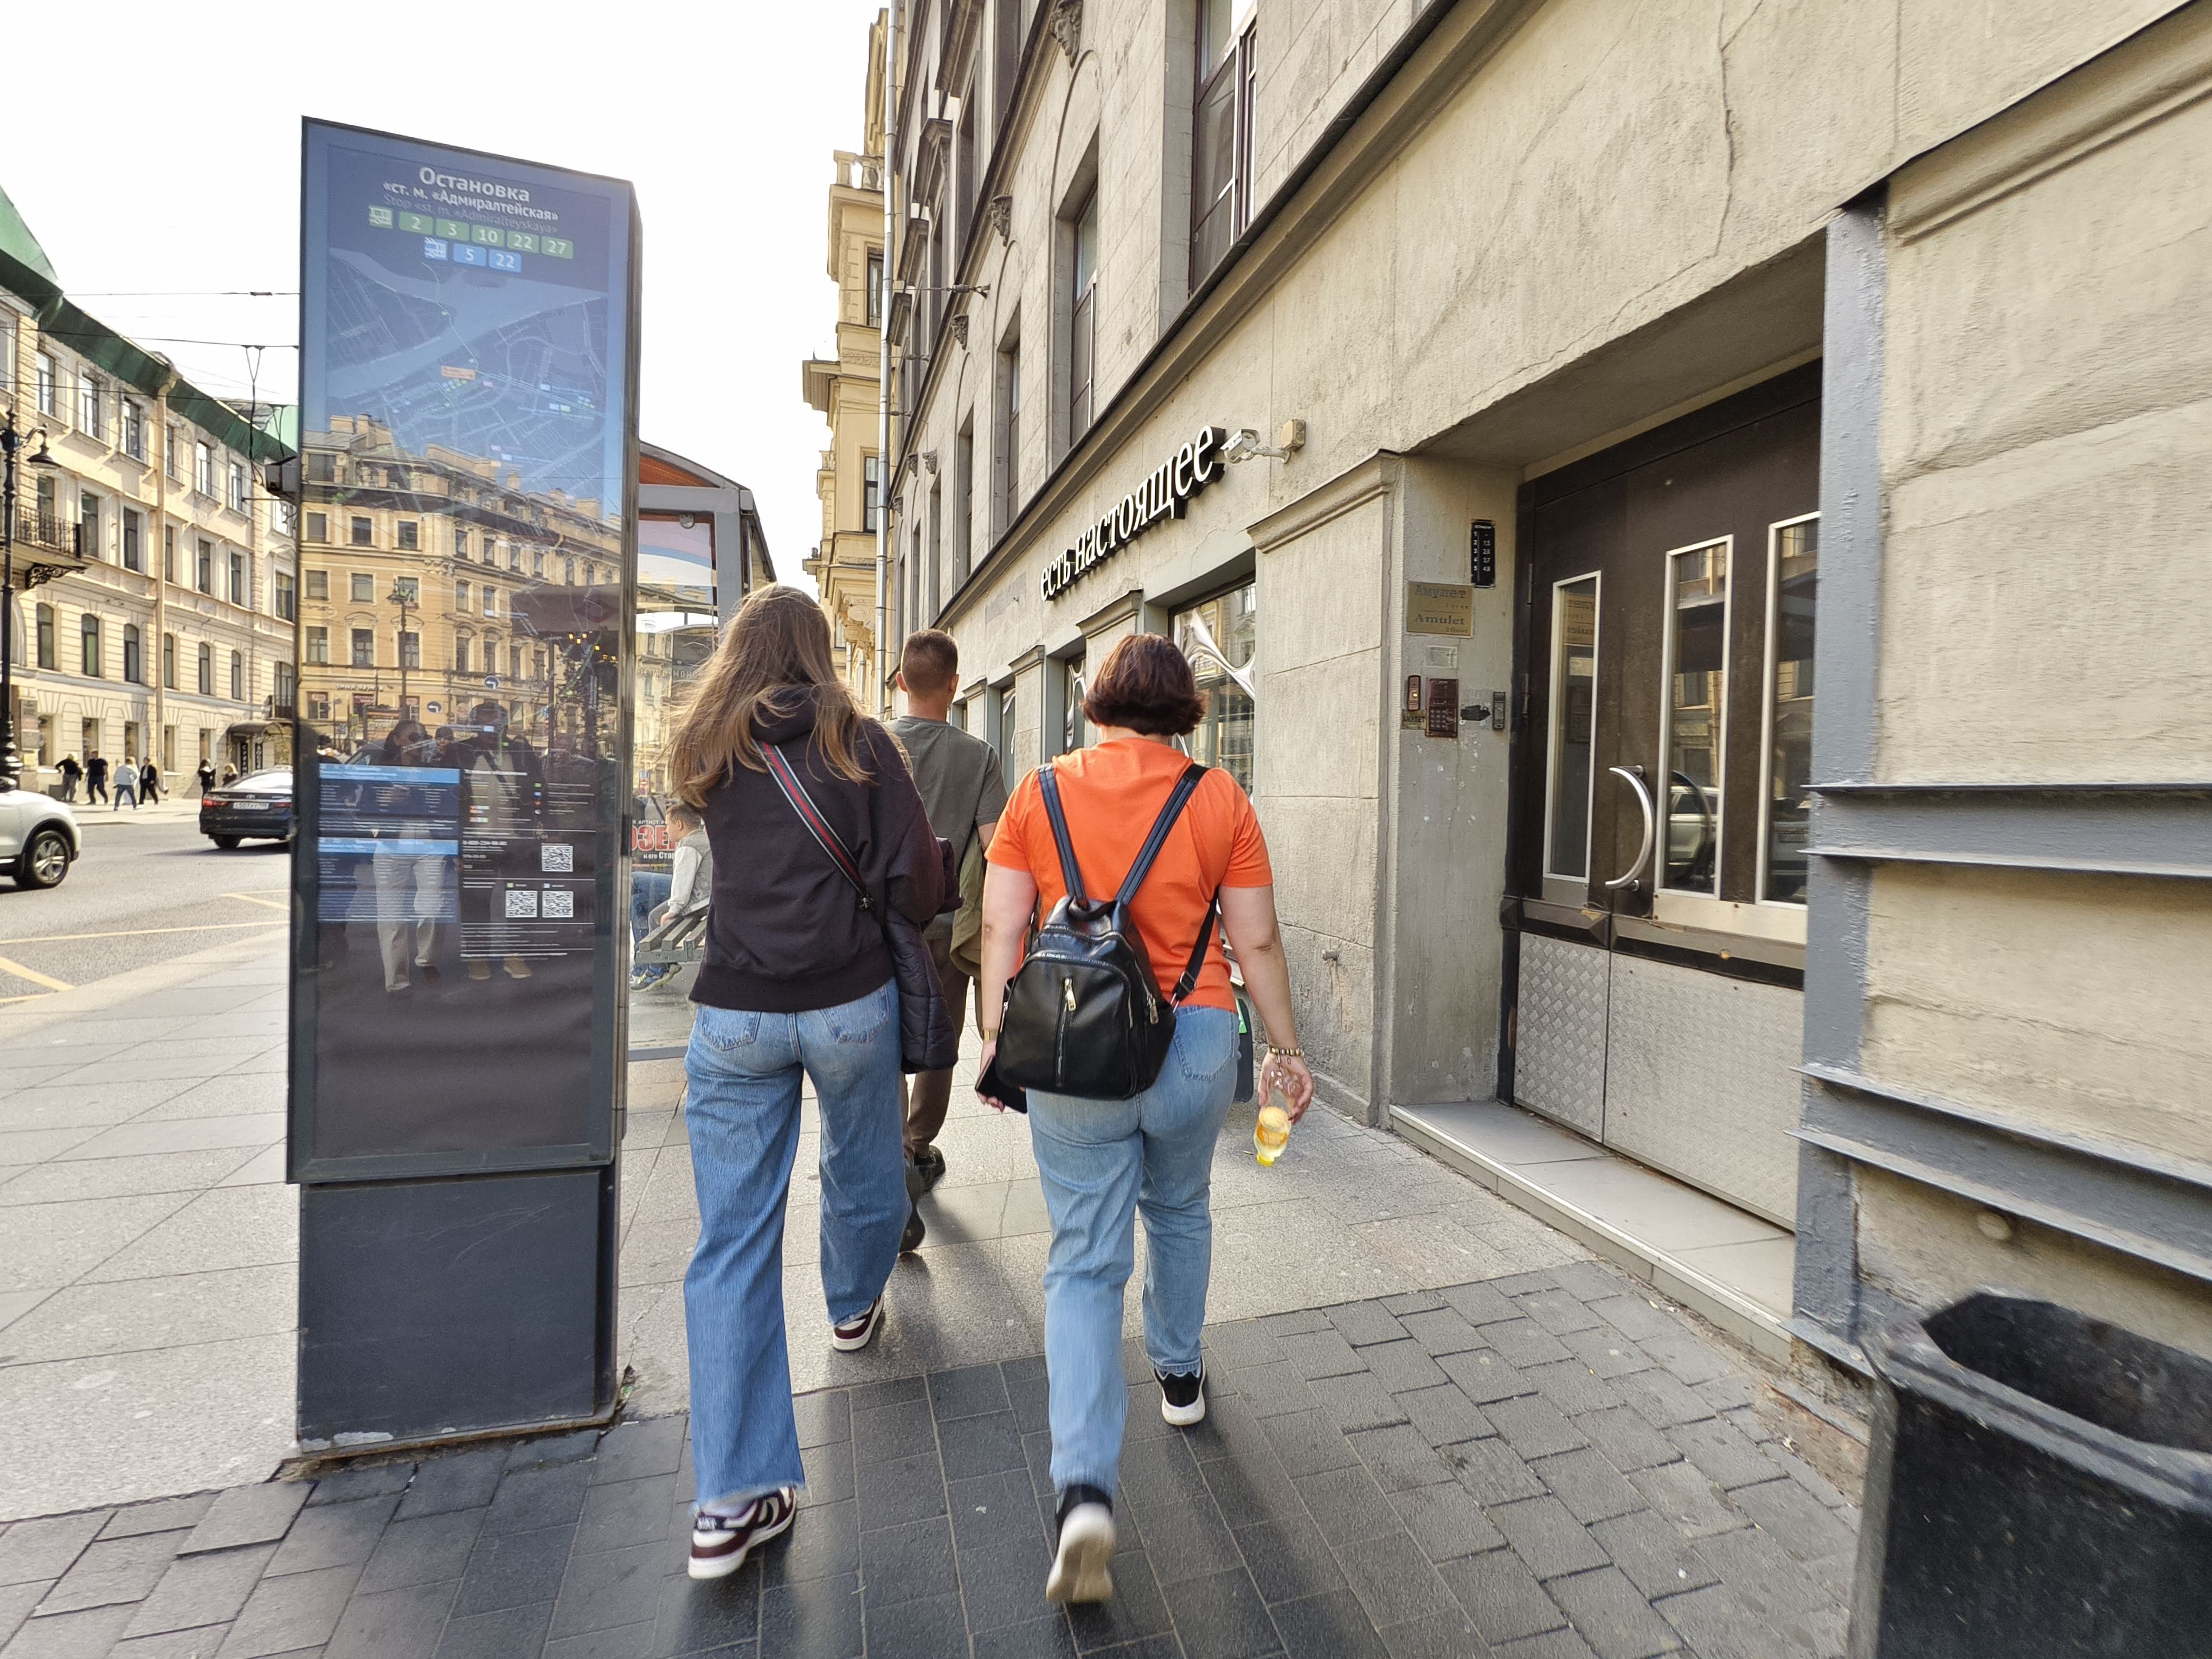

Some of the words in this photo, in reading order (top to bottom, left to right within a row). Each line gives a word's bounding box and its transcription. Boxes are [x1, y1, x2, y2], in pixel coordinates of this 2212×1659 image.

[383, 181, 411, 196] «ст.
[419, 166, 530, 203] Остановка
[411, 217, 421, 230] 2
[447, 223, 458, 236] 3
[479, 229, 498, 243] 10
[515, 235, 533, 249] 22
[548, 241, 567, 255] 27
[466, 249, 474, 262] 5
[496, 253, 515, 268] 22
[1040, 549, 1071, 601] есть
[1075, 425, 1213, 575] настоящее
[1414, 614, 1465, 625] Amulet
